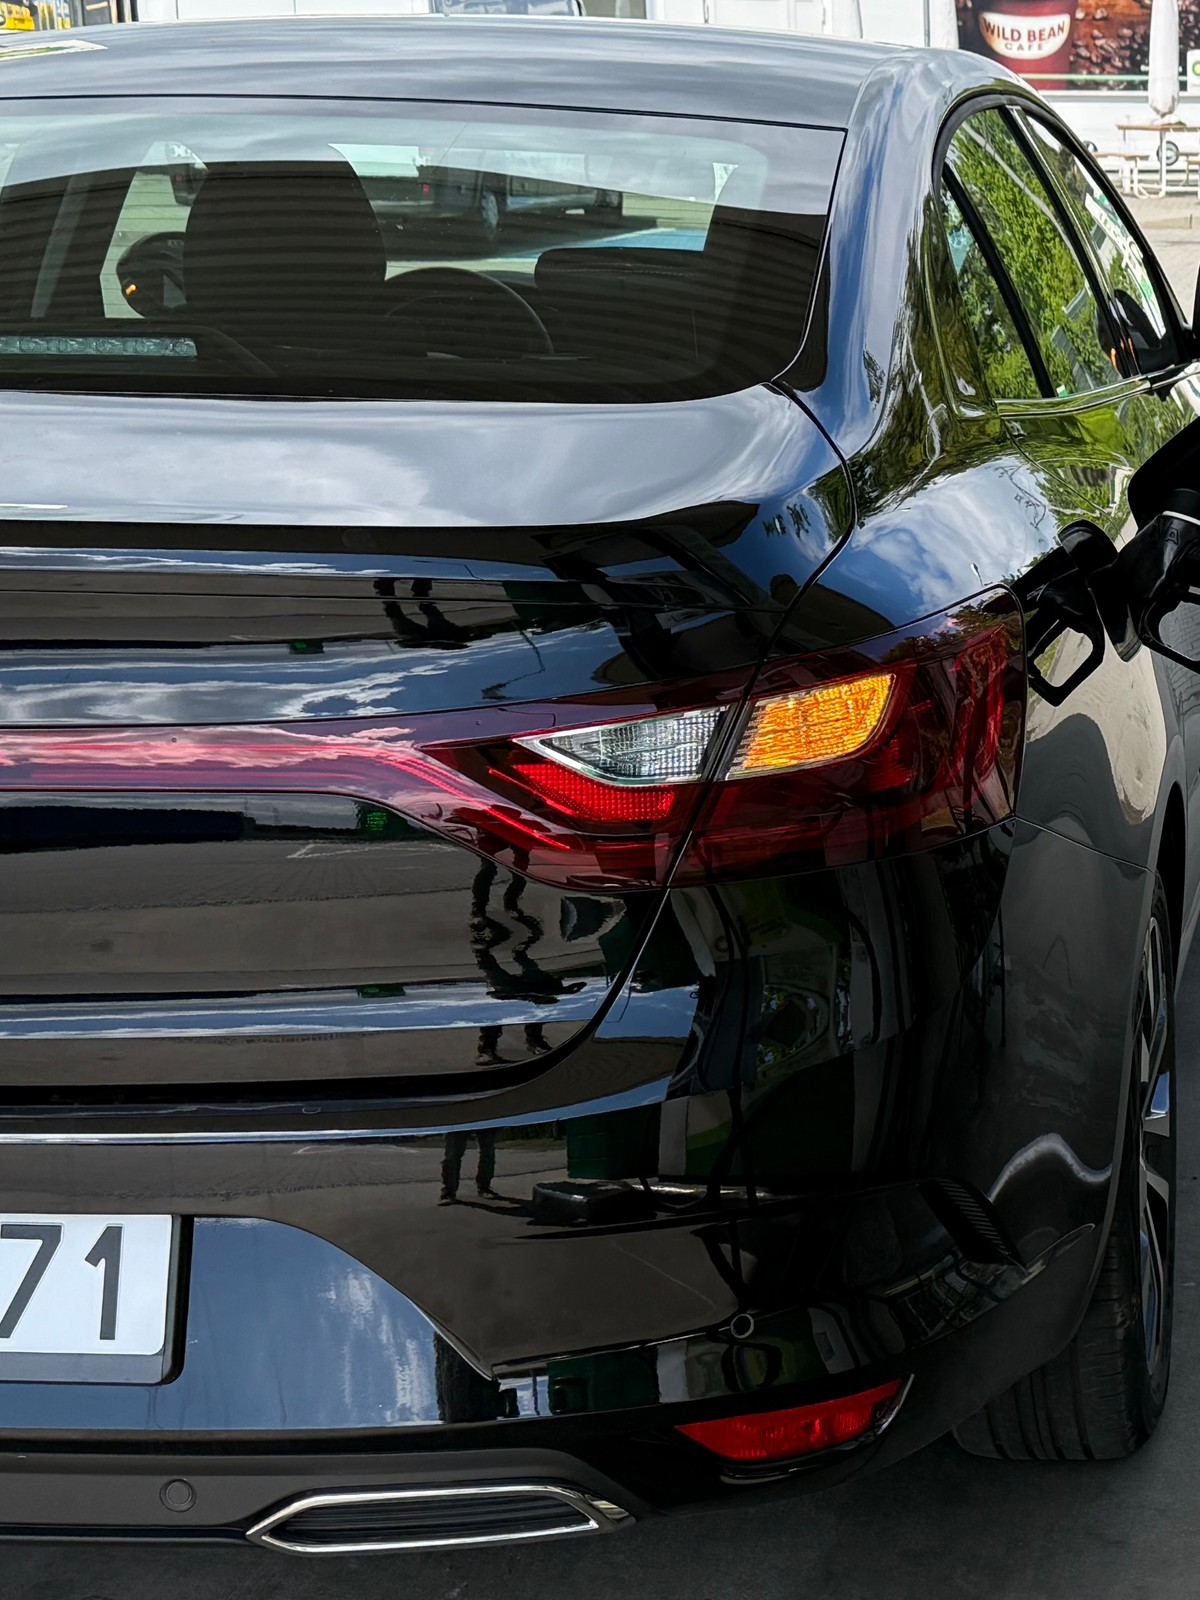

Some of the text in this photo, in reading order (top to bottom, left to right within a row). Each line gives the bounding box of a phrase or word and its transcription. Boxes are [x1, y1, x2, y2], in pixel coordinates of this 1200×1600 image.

[983, 16, 1065, 42] WILD BEAN
[0, 1223, 124, 1341] 71
